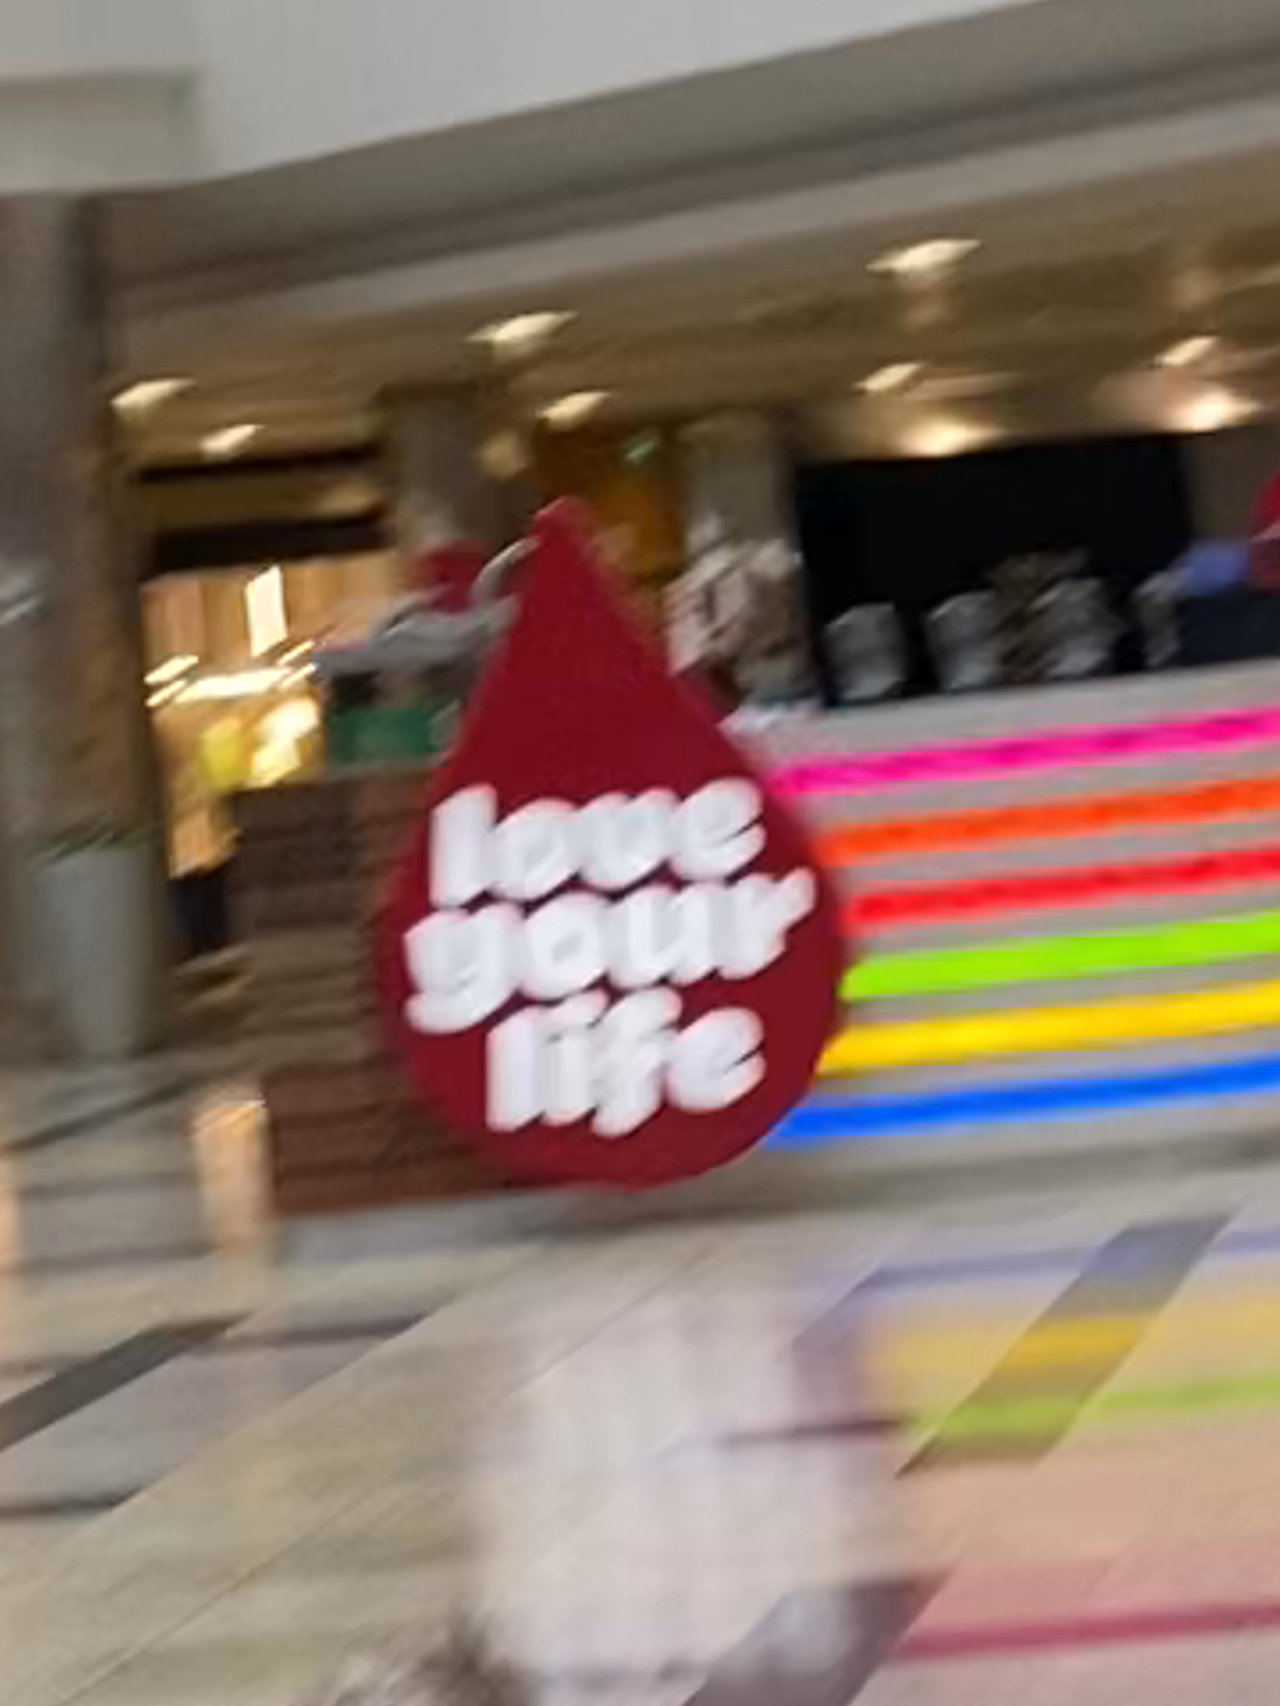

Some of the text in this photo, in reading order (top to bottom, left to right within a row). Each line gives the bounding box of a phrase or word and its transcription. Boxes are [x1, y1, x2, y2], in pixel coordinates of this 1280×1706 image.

[429, 776, 765, 909] love
[403, 866, 816, 1035] your
[485, 986, 767, 1137] life
